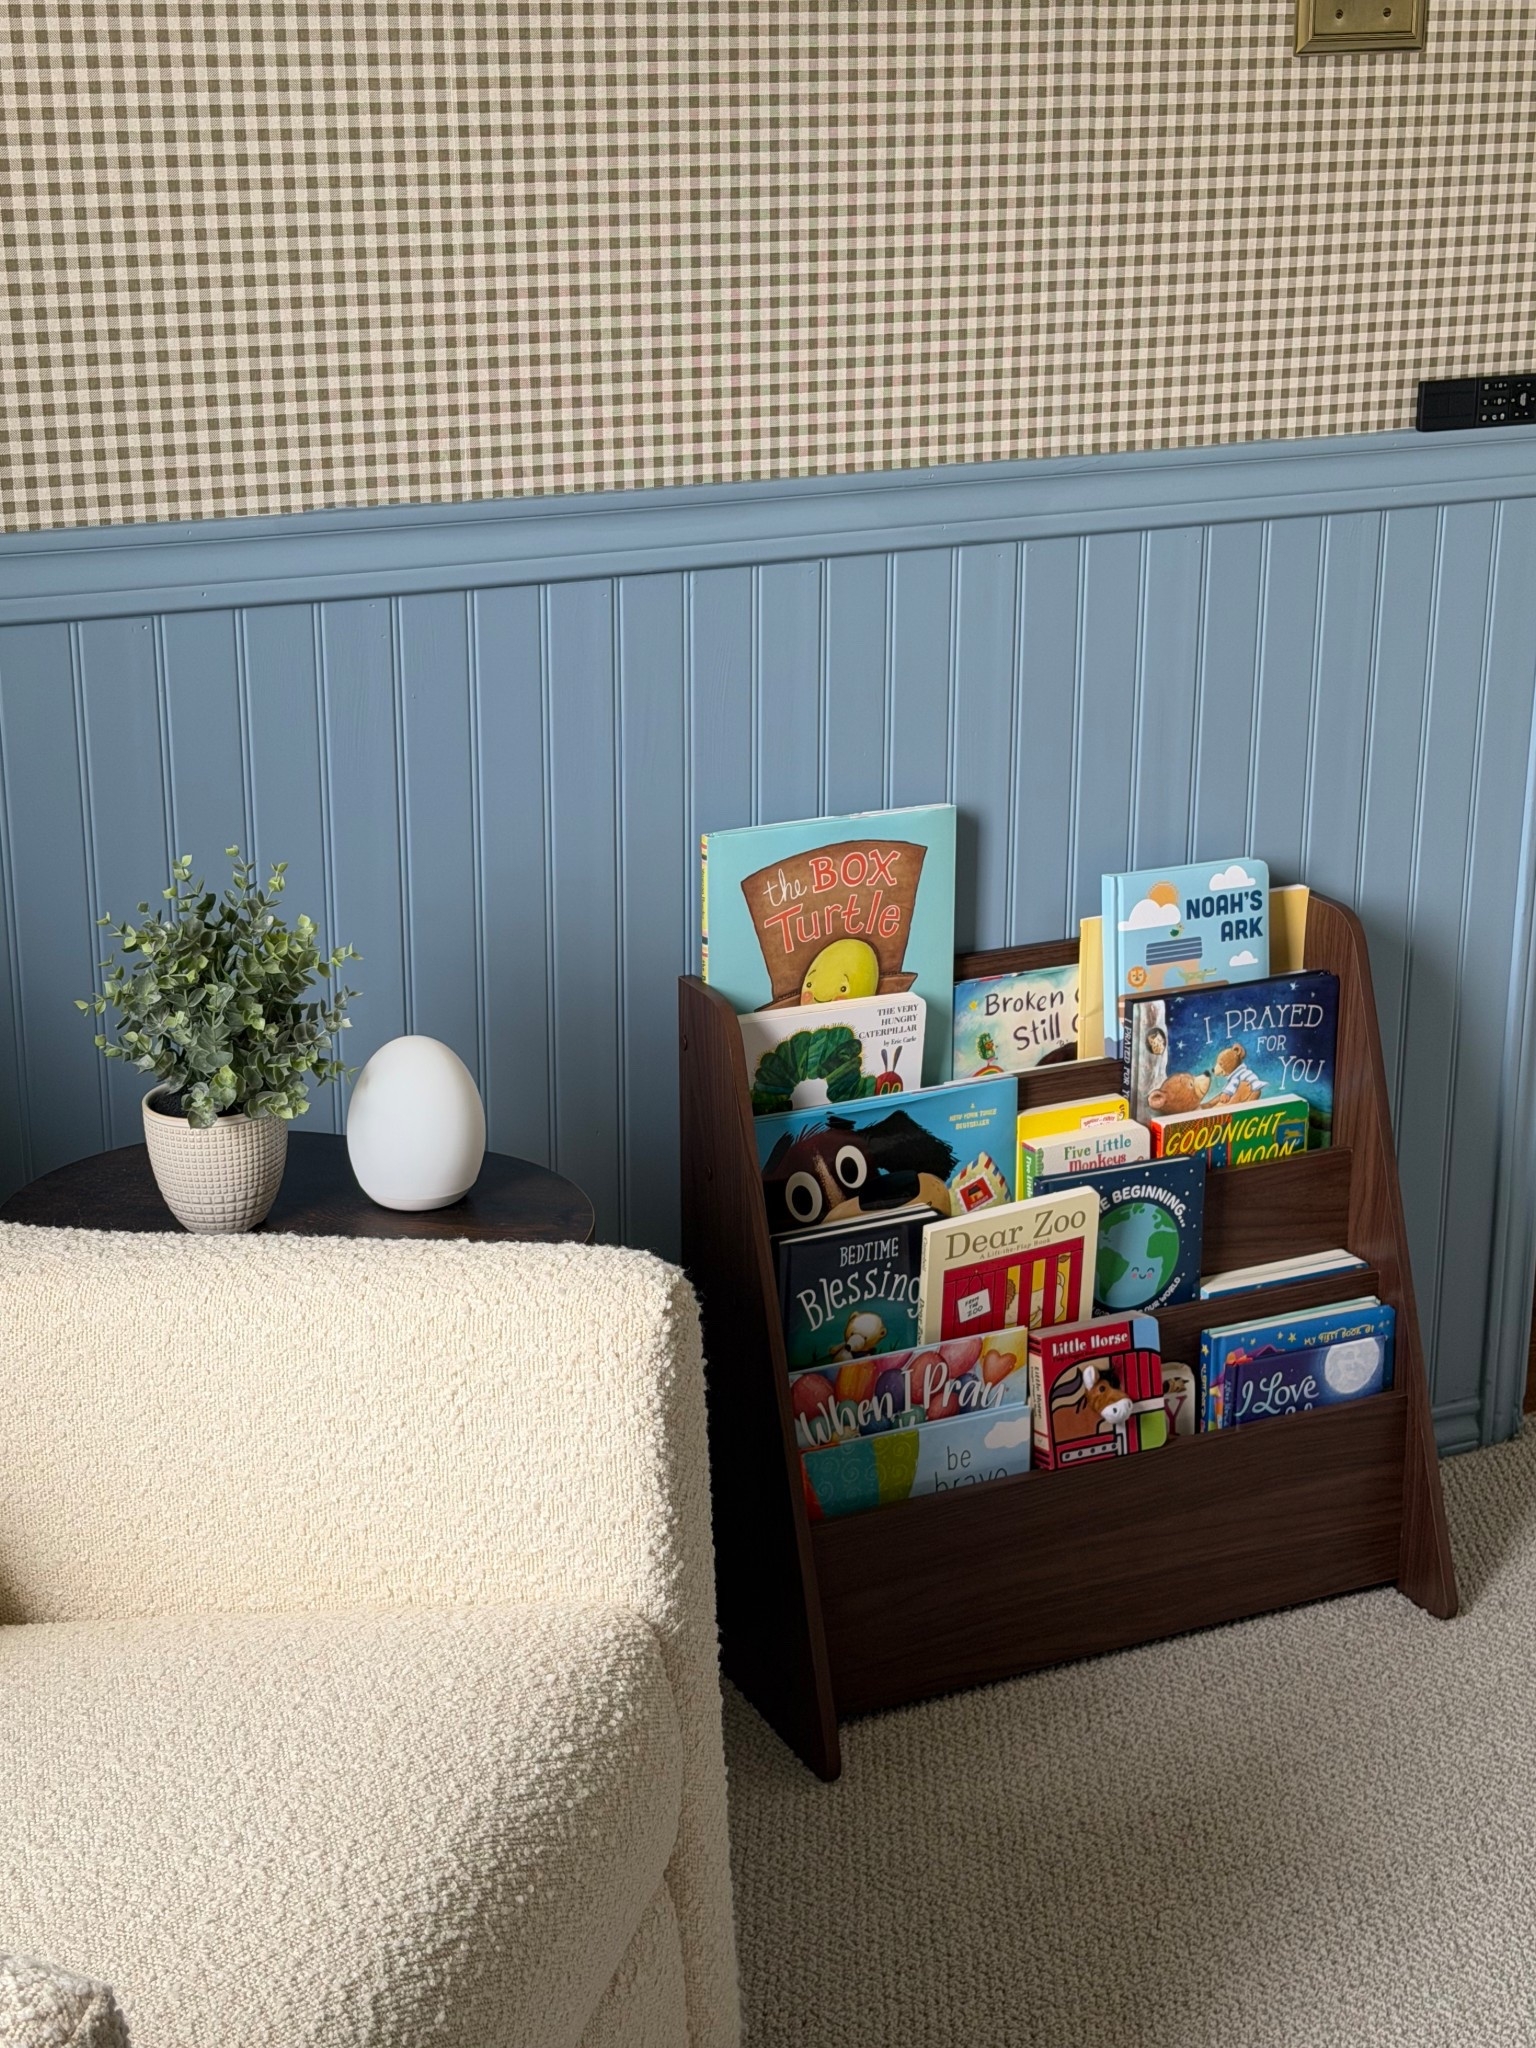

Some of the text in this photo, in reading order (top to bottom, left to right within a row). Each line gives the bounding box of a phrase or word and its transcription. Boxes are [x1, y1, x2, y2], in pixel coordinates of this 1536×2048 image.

[763, 849, 901, 907] the BOX
[1186, 890, 1263, 920] NOAH'S
[764, 890, 901, 954] Turtle
[1221, 916, 1263, 942] ARK
[877, 1003, 919, 1017] THE VERY
[984, 990, 1064, 1016] Broken
[858, 1024, 917, 1039] CATERPILLAR
[881, 1013, 918, 1026] HUNGRY
[1013, 1011, 1061, 1051] Still
[1203, 1004, 1324, 1045] I PRAYED
[1256, 1034, 1287, 1053] FOR
[1122, 1066, 1131, 1086] FOR
[1278, 1055, 1326, 1090] YOU
[1166, 1110, 1287, 1156] GOODNIGHT
[1064, 1134, 1132, 1161] Five Little
[1236, 1139, 1297, 1165] MOON
[944, 1210, 1086, 1261] Dear Zoo
[840, 1237, 899, 1267] BEDTIME
[1159, 1276, 1181, 1303] WORLD
[967, 1305, 983, 1317] ZOO
[1052, 1338, 1087, 1357] Little
[1090, 1332, 1128, 1349] Horse
[800, 1391, 895, 1447] When
[898, 1369, 914, 1414] I
[924, 1361, 1006, 1410] Pray
[1234, 1380, 1253, 1417] I
[1252, 1371, 1319, 1415] Love
[946, 1445, 971, 1471] be
